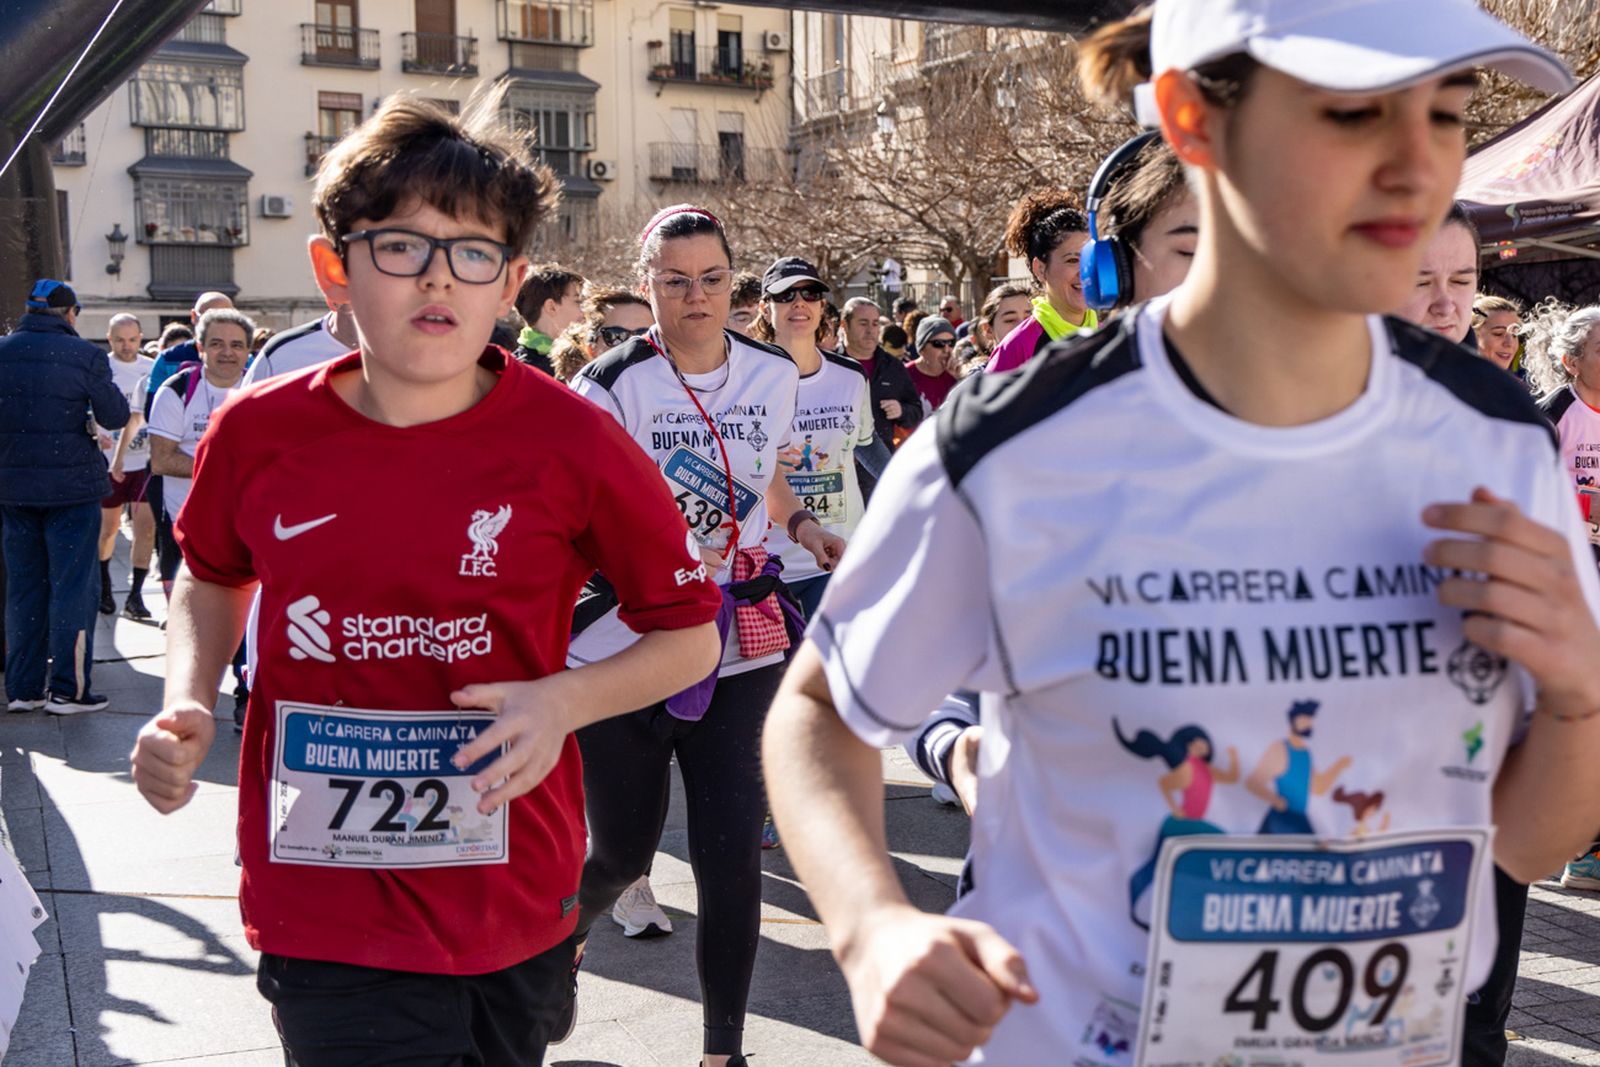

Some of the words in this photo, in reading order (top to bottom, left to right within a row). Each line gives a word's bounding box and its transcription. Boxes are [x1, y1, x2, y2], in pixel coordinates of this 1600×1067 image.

[653, 414, 663, 424] VI
[798, 416, 840, 432] MUERTE
[813, 405, 853, 415] CAMINATA
[652, 430, 700, 450] BUENA
[674, 564, 707, 586] Exp
[1087, 575, 1128, 606] VI
[1136, 568, 1314, 603] CARRERA
[1324, 562, 1462, 599] CAMIN
[342, 613, 488, 642] standard
[343, 630, 492, 664] chartered
[1095, 628, 1249, 686] BUENA
[1262, 620, 1439, 683] MUERTE
[308, 720, 323, 736] VI
[326, 722, 393, 742] CARRERA
[396, 724, 479, 742] CAMINATA
[305, 742, 362, 770] BUENA
[366, 747, 441, 771] MUERTE
[327, 777, 450, 832] 722
[332, 833, 370, 844] MANUEL
[1209, 859, 1234, 882] VI
[1237, 858, 1347, 884] CARRERA
[1352, 850, 1444, 884] CAMINATA
[1203, 892, 1294, 933] BUENA
[1300, 892, 1402, 934] MUERTE
[1222, 941, 1411, 1034] 409
